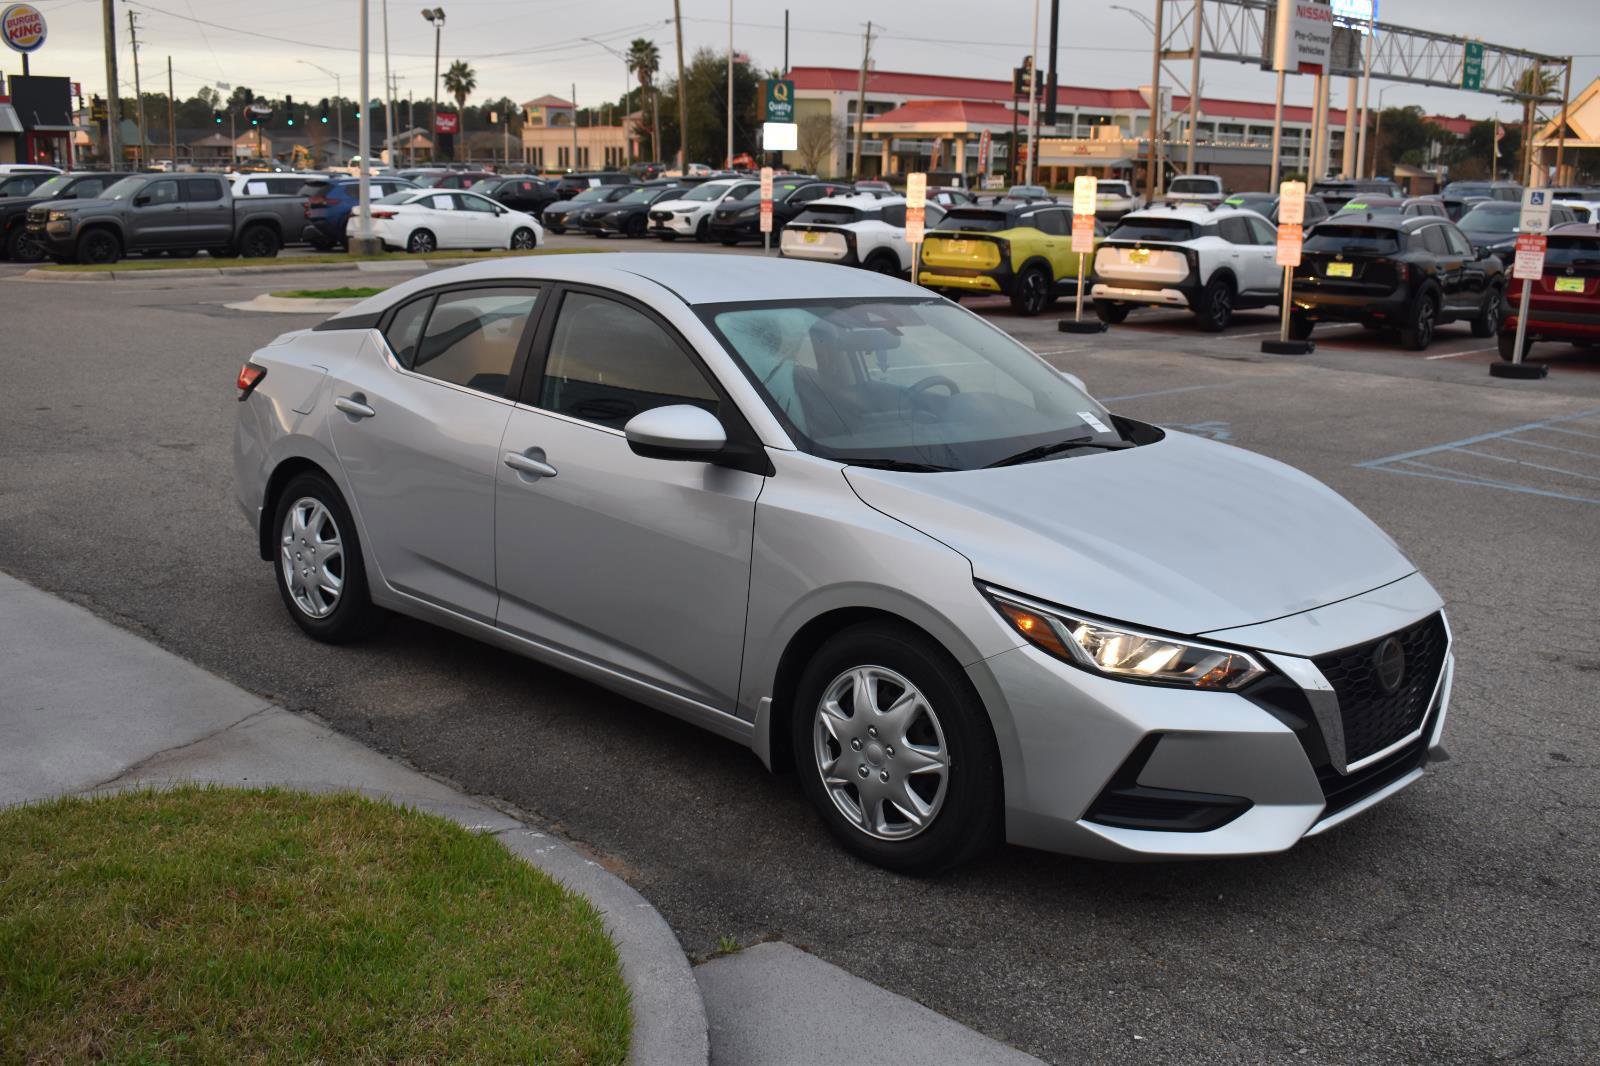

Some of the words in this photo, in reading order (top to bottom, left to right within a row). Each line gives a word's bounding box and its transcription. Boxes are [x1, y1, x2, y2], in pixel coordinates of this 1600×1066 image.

[7, 13, 40, 28] BURGER
[1296, 5, 1331, 22] NISSAN
[9, 23, 42, 40] KING
[1295, 30, 1330, 44] Pre-Owned
[1298, 45, 1325, 56] Vehicles
[768, 101, 792, 113] Quality
